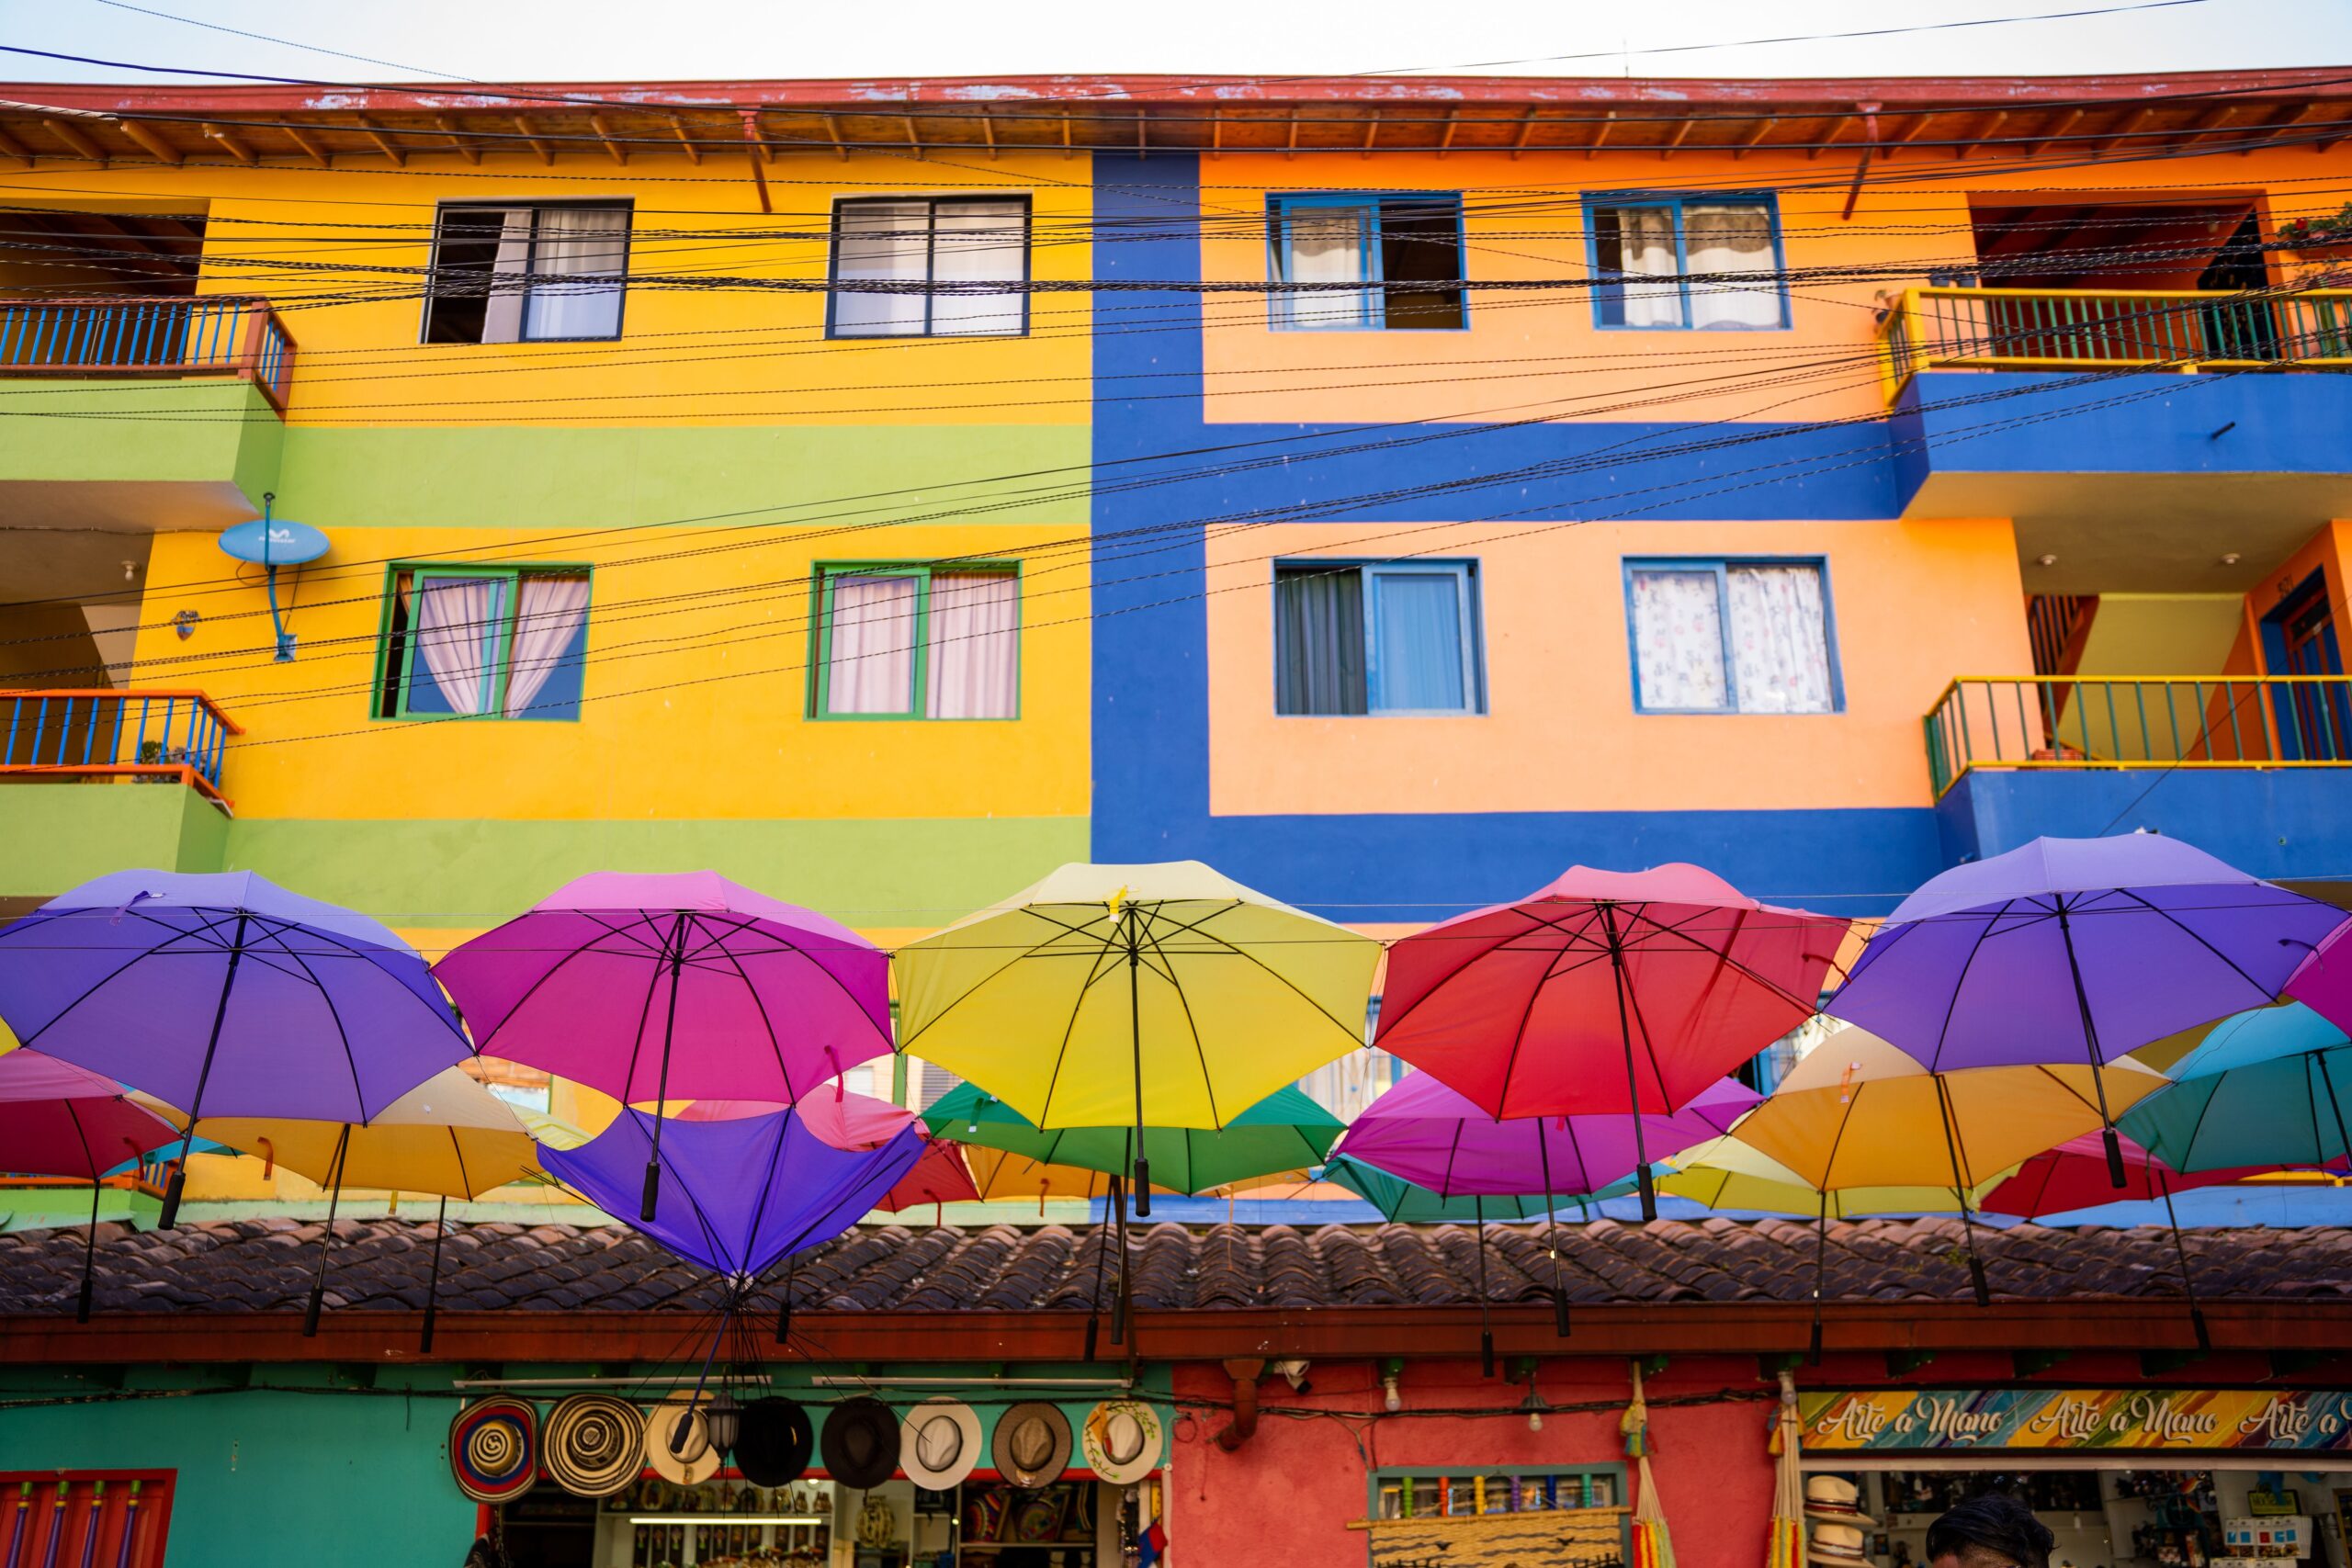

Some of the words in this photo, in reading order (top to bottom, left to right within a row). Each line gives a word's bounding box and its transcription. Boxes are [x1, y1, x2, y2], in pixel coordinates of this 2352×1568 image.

[1817, 1397, 1885, 1440] Arte
[1894, 1413, 1913, 1432] a
[1916, 1396, 2003, 1441] Mano
[2030, 1396, 2099, 1440] Arte
[2109, 1413, 2128, 1432] a
[2131, 1395, 2218, 1442] Mano
[2239, 1396, 2309, 1442] Arte
[2320, 1414, 2338, 1433] a
